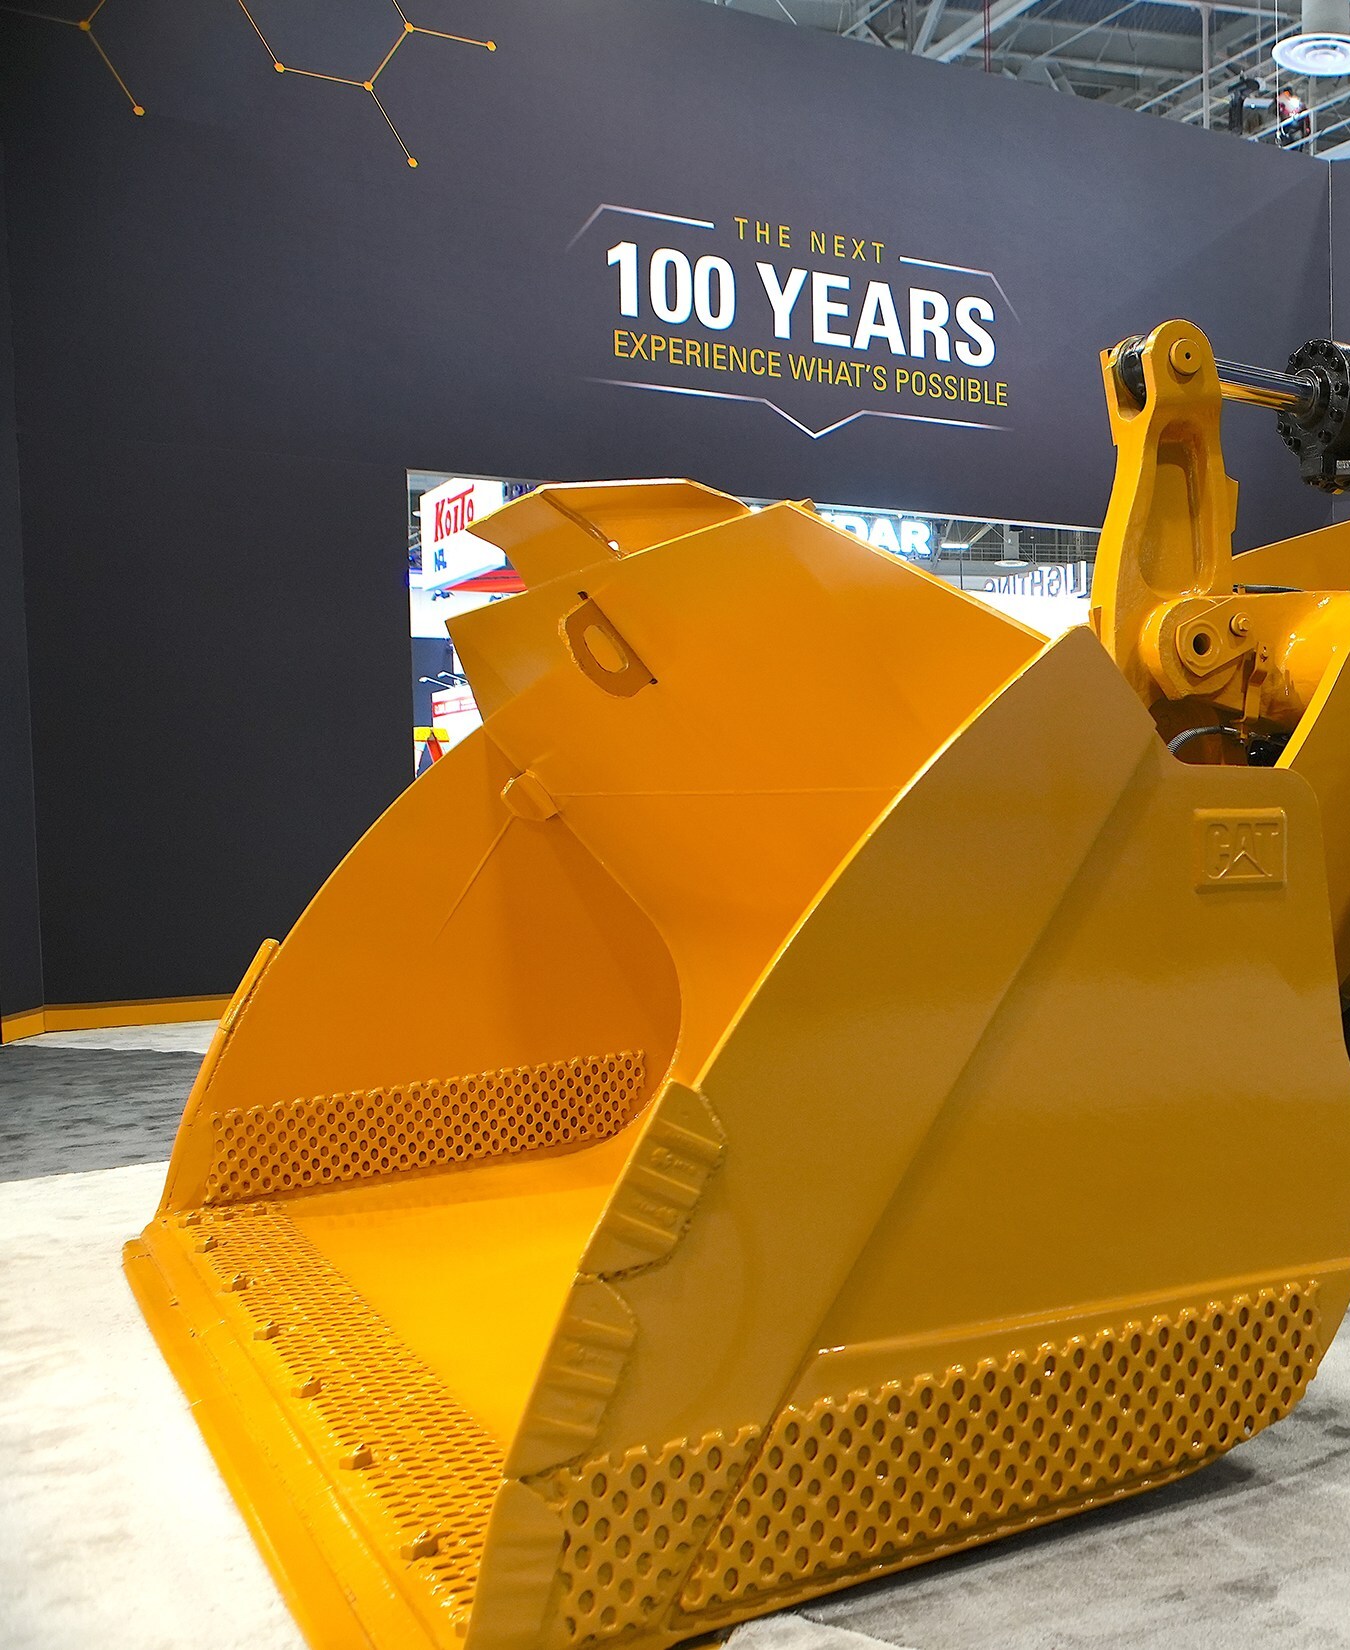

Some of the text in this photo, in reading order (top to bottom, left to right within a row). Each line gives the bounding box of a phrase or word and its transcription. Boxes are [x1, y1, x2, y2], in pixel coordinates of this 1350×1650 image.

[734, 217, 885, 264] THE NEXT
[606, 240, 997, 367] 100 YEARS
[613, 329, 1008, 407] EXPERIENCE WHAT'S POSSIBLE
[821, 512, 932, 555] DAR
[1206, 822, 1279, 879] CAT
